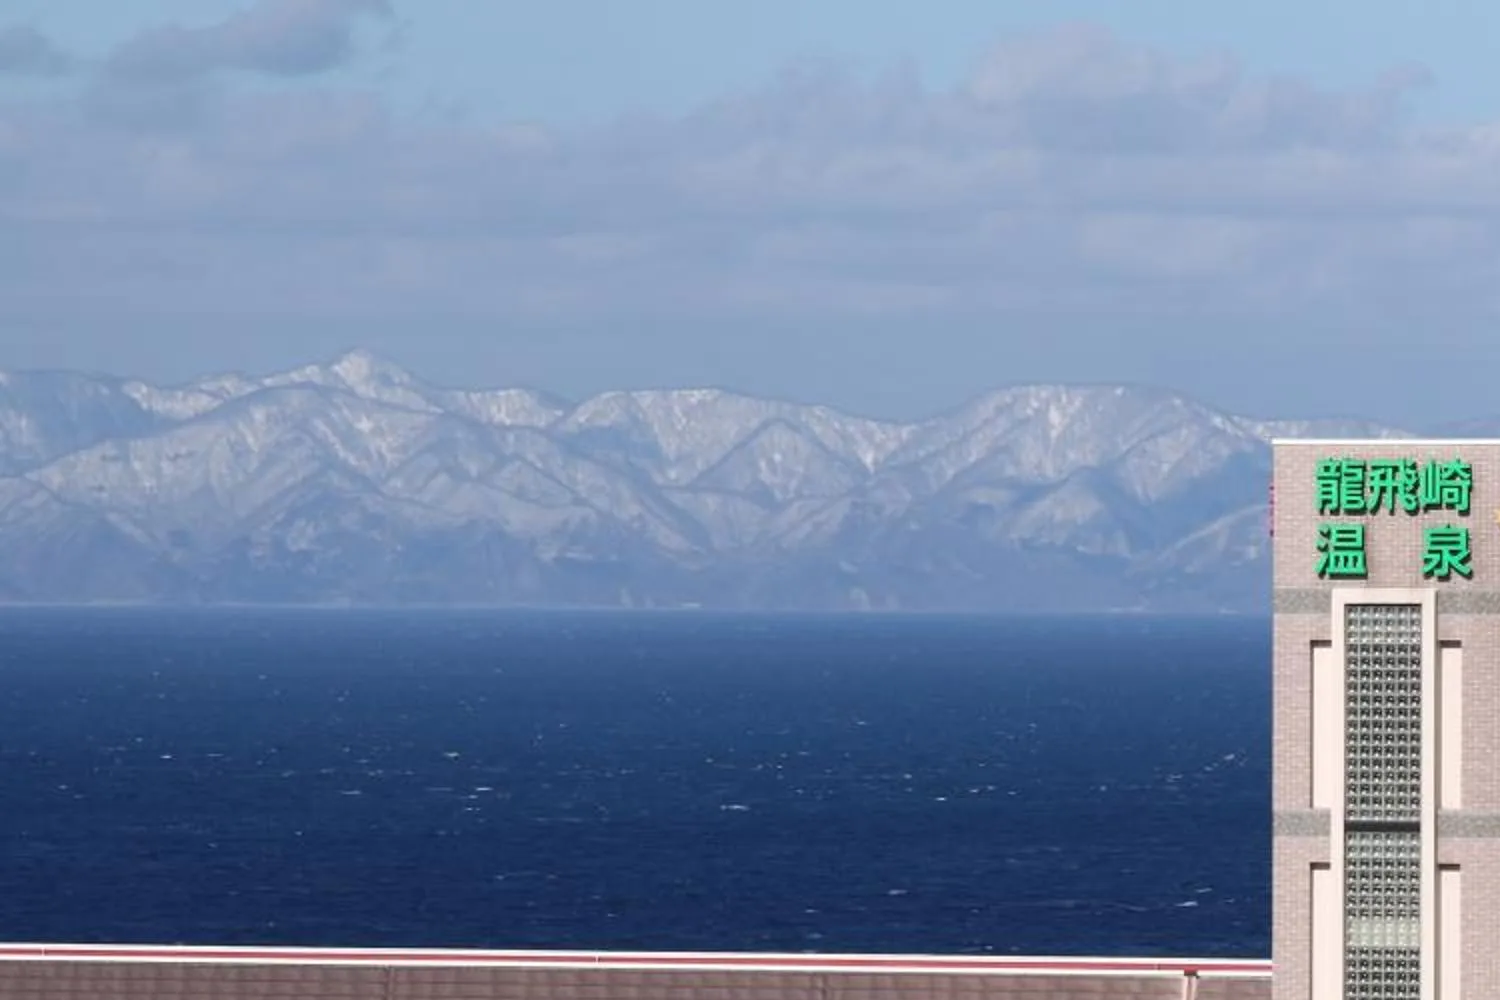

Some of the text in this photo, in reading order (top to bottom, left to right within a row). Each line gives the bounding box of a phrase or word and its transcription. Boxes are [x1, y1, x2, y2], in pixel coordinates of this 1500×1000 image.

[1315, 458, 1473, 515] 龍飛崎
[1315, 523, 1473, 579] 温泉
